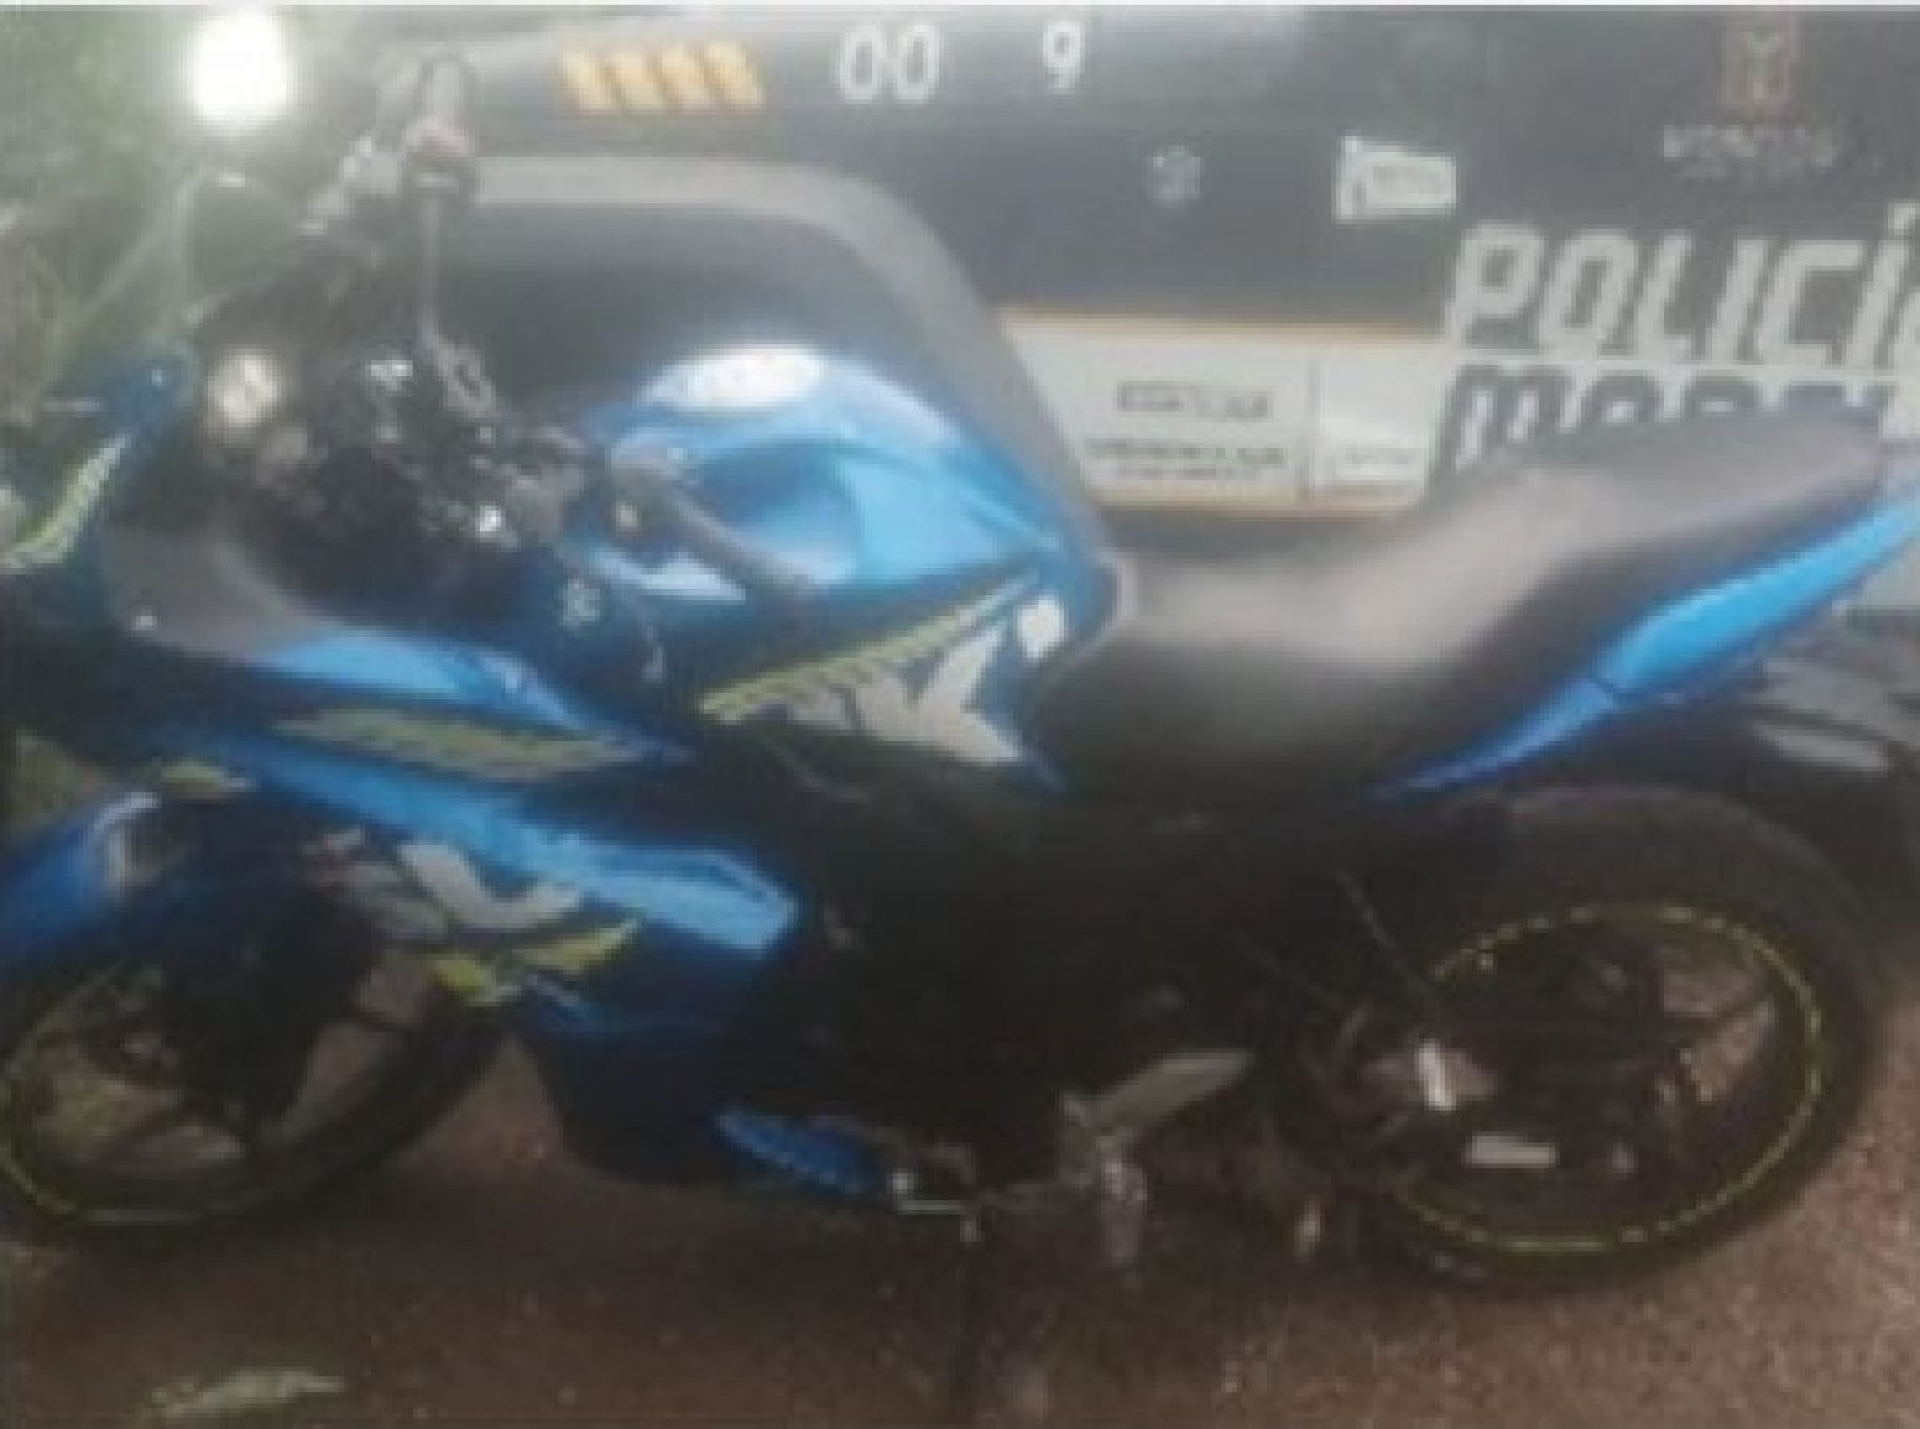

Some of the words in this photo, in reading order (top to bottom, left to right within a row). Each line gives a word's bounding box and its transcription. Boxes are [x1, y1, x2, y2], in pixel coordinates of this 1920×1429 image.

[838, 25, 941, 103] 00
[1042, 20, 1085, 93] 9
[1445, 204, 1920, 370] POLICÍ
